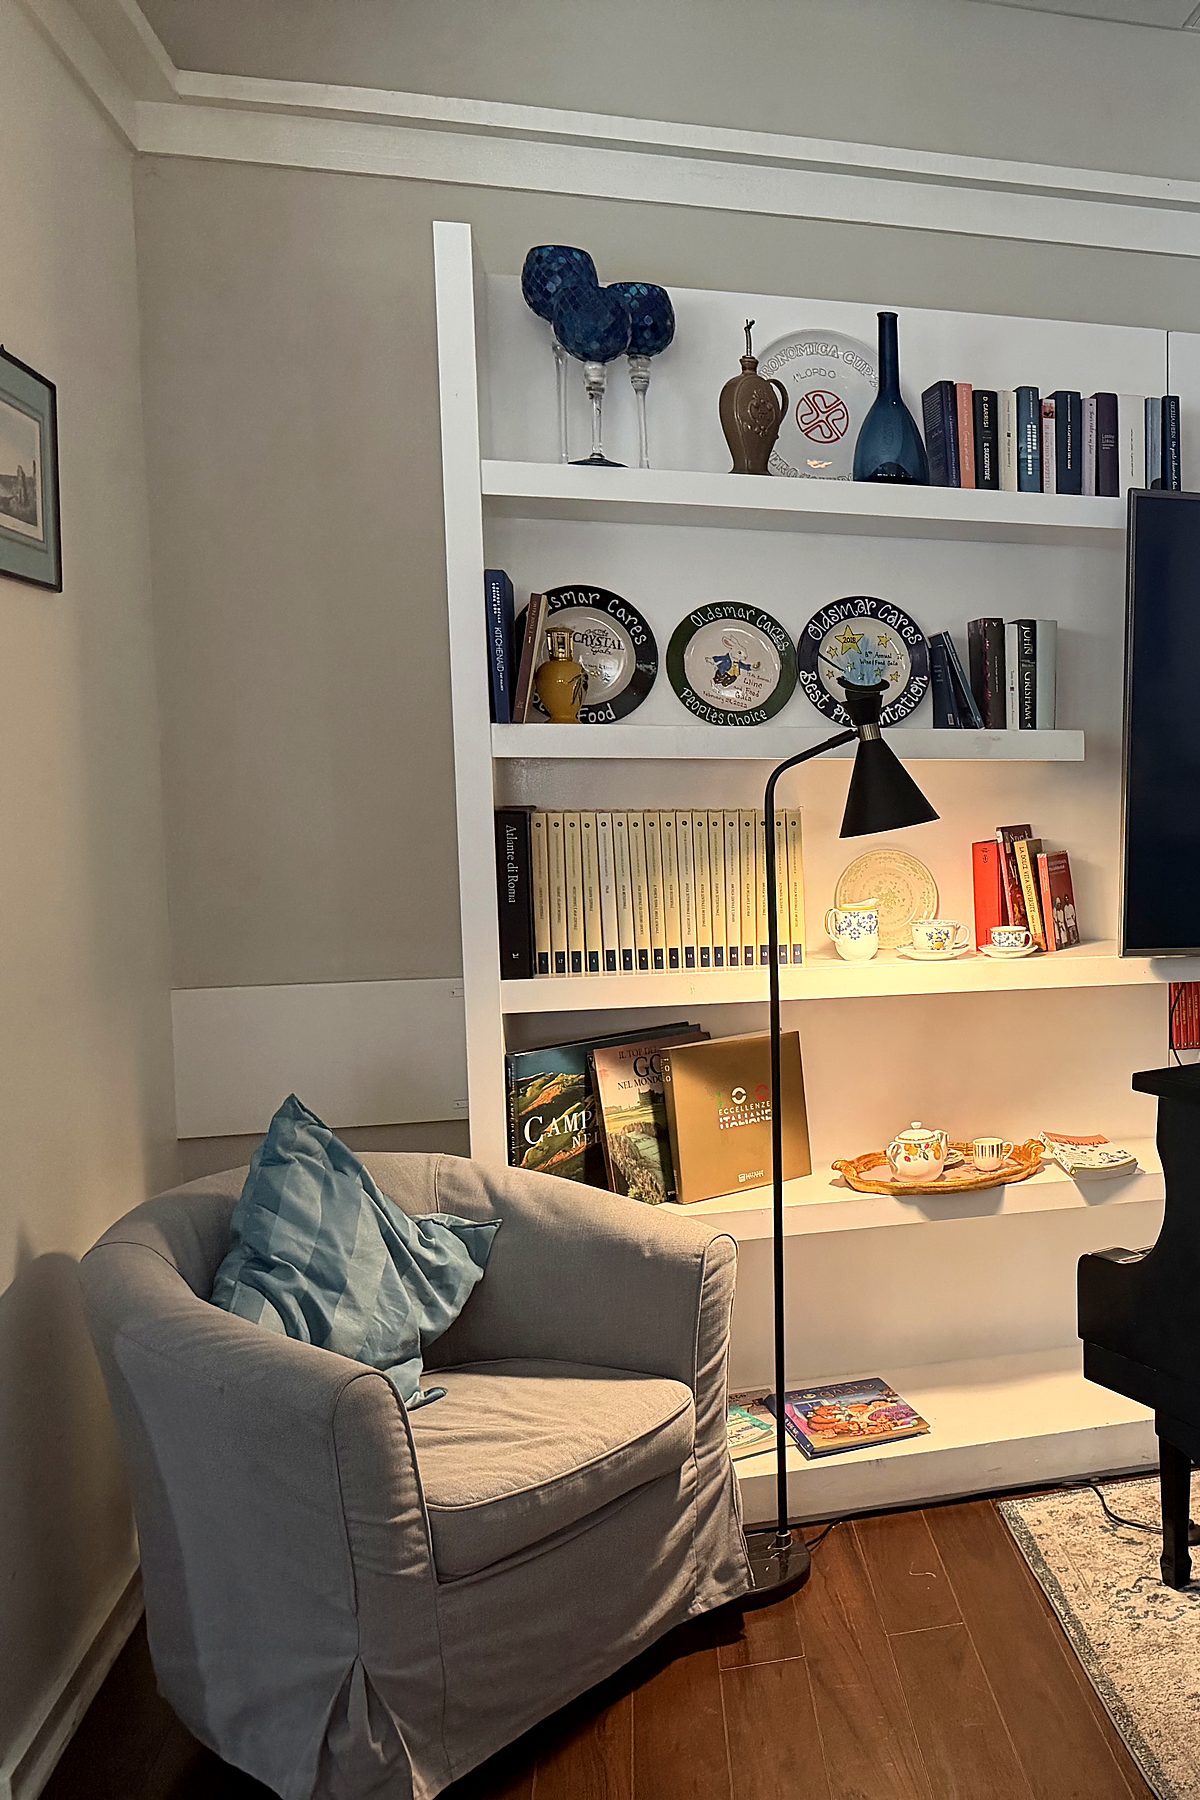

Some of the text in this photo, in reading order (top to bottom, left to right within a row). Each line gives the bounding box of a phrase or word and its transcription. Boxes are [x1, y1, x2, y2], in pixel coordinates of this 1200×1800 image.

[549, 591, 647, 645] smar Cares
[690, 605, 790, 652] Oldsmar Cares
[807, 598, 923, 645] Oldsmar Cares
[494, 627, 505, 673] KITCHENAID
[573, 631, 625, 651] CRYSTAL
[1020, 625, 1034, 720] JOHN GRISHAM
[799, 670, 830, 710] Best
[577, 702, 617, 723] Food
[727, 709, 768, 726] Choice
[505, 824, 519, 903] Atlante di Roma
[633, 1053, 662, 1078] GO
[617, 1080, 633, 1090] NEL
[719, 1100, 771, 1116] ECCELLENZE
[719, 1108, 772, 1130] ITALIANE
